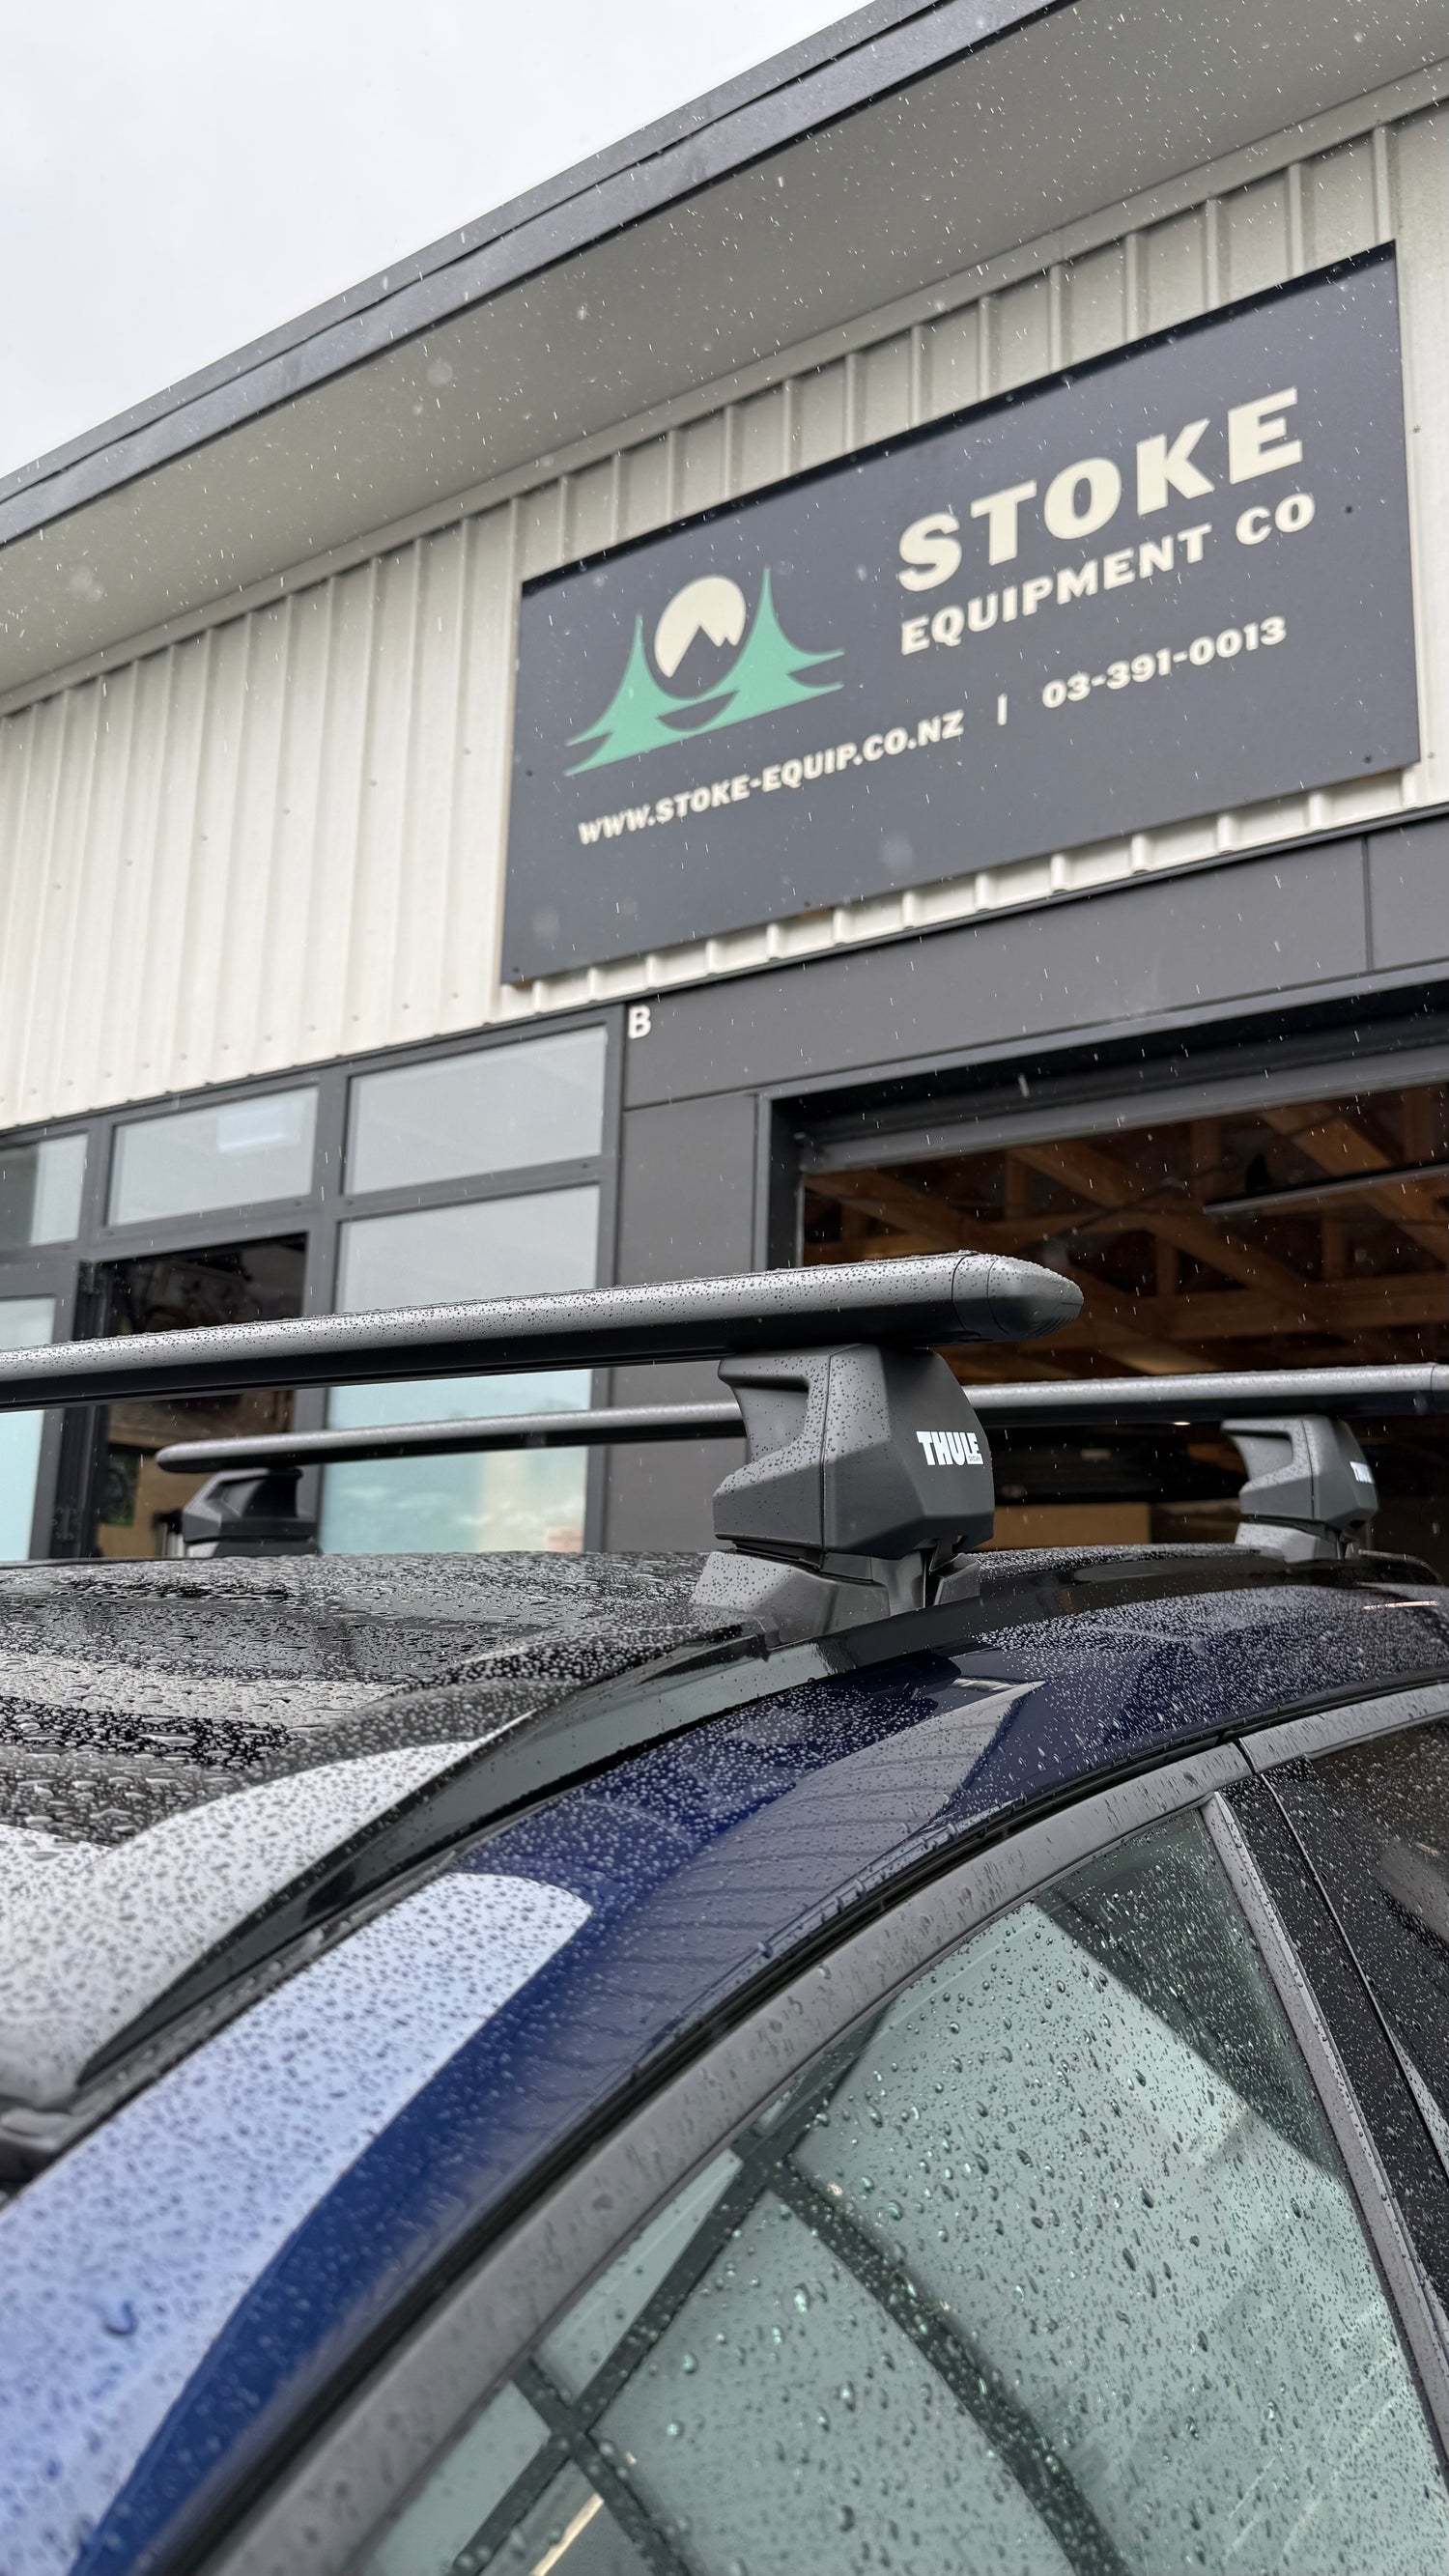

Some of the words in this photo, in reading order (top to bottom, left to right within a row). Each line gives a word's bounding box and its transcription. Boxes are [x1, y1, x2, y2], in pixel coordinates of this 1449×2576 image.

[897, 386, 1303, 592] STOKE
[899, 523, 1213, 656] EQUIPMENT
[1236, 493, 1317, 546] CO
[578, 708, 965, 845] WWW.STOKE-EQUIP.CO.NZ
[1041, 615, 1288, 709] 03-391-0013
[628, 1005, 653, 1040] B
[915, 1430, 984, 1466] THULE
